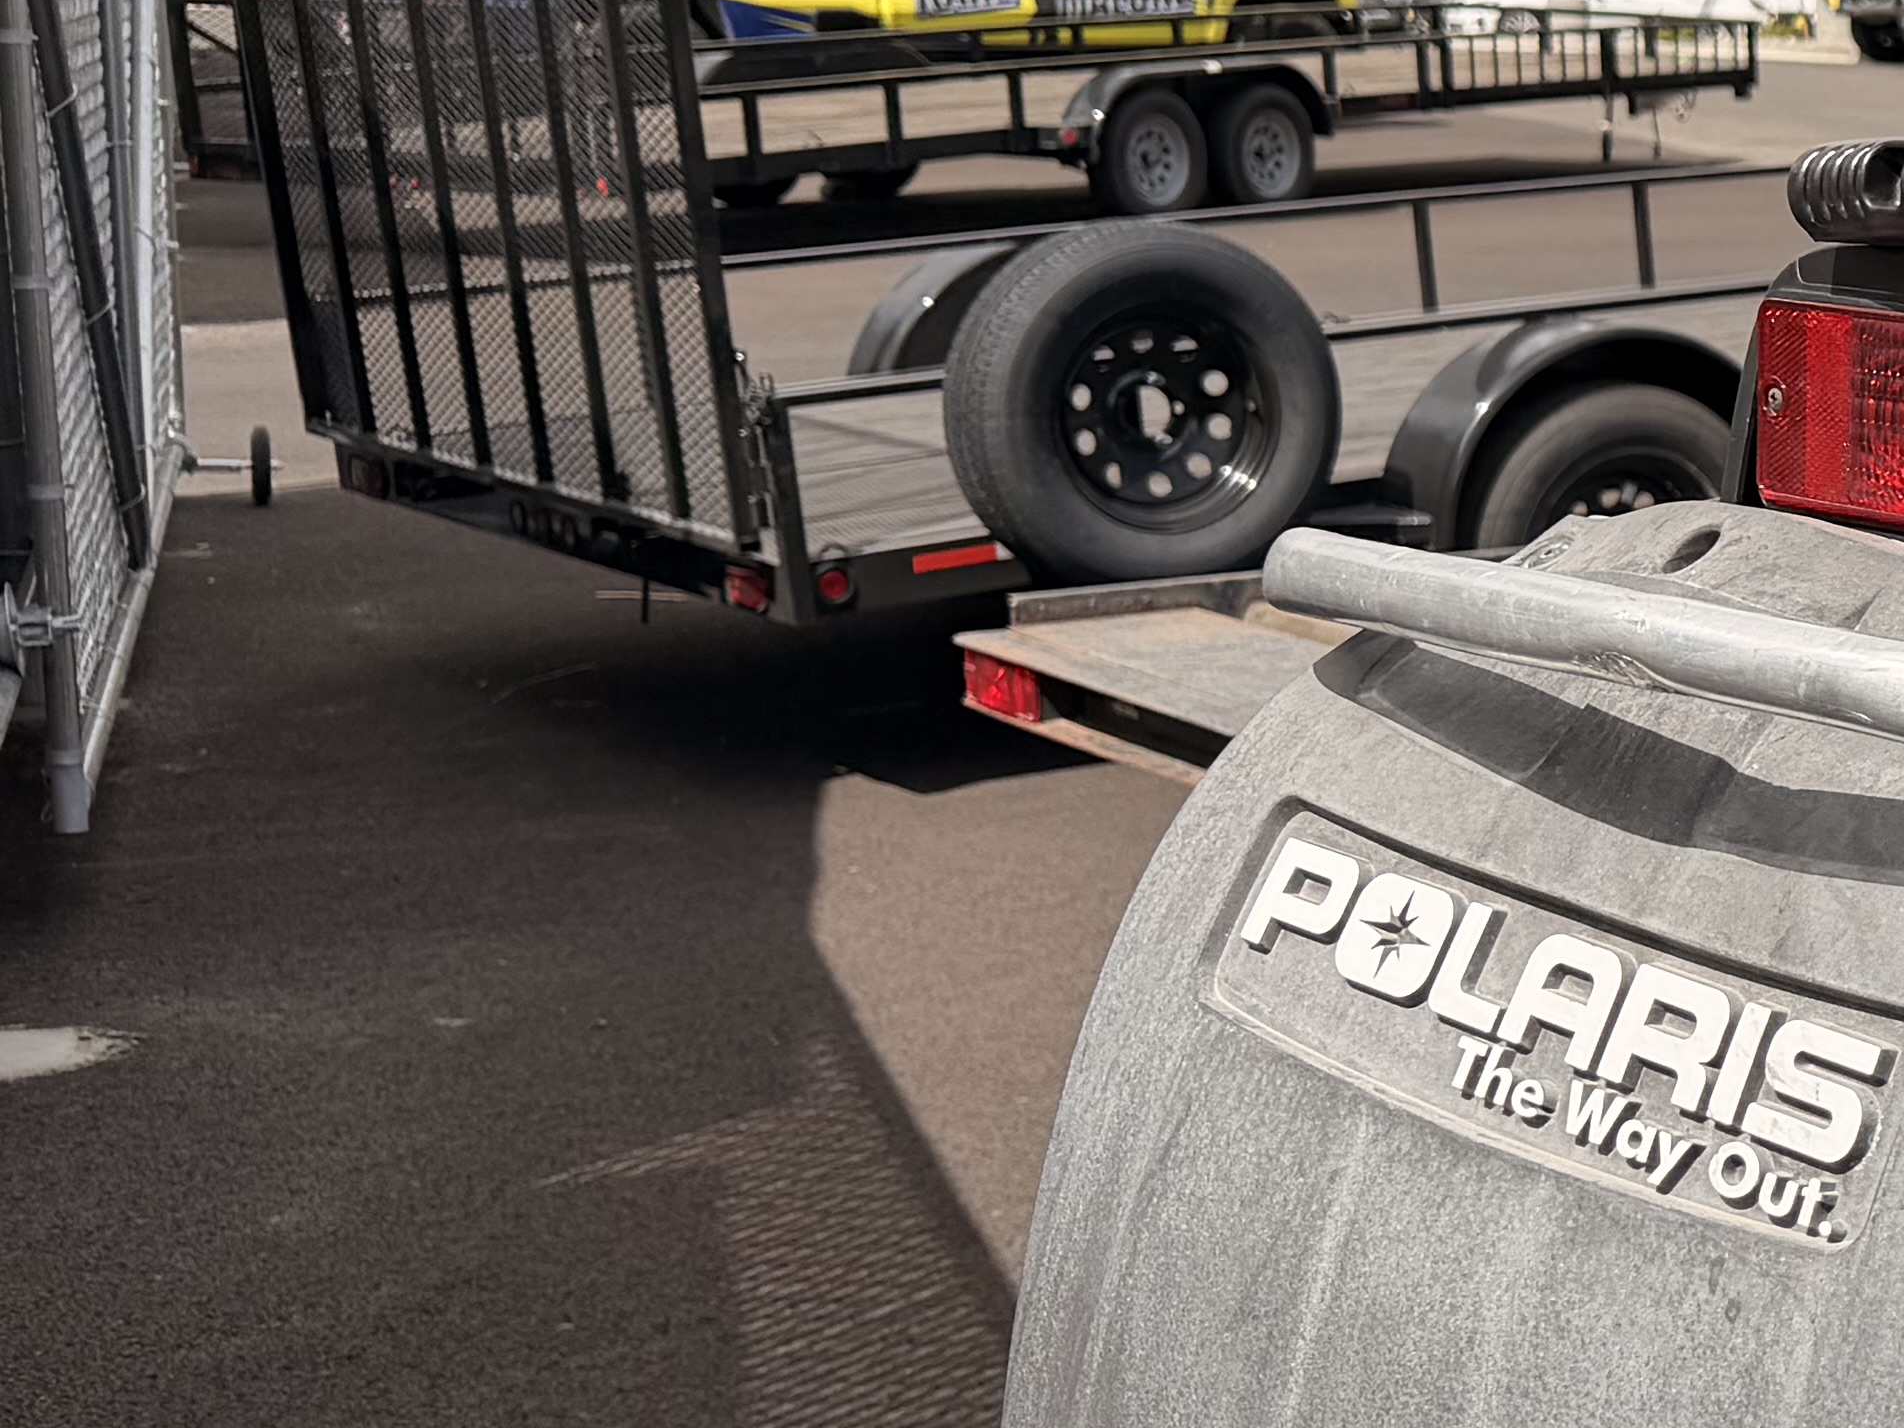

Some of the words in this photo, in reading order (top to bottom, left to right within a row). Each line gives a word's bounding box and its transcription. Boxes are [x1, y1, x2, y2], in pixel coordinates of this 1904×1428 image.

[1242, 837, 1890, 1167] POLARIS
[1451, 1036, 1547, 1121] The
[1566, 1080, 1695, 1190] Way
[1708, 1142, 1835, 1240] Out.
